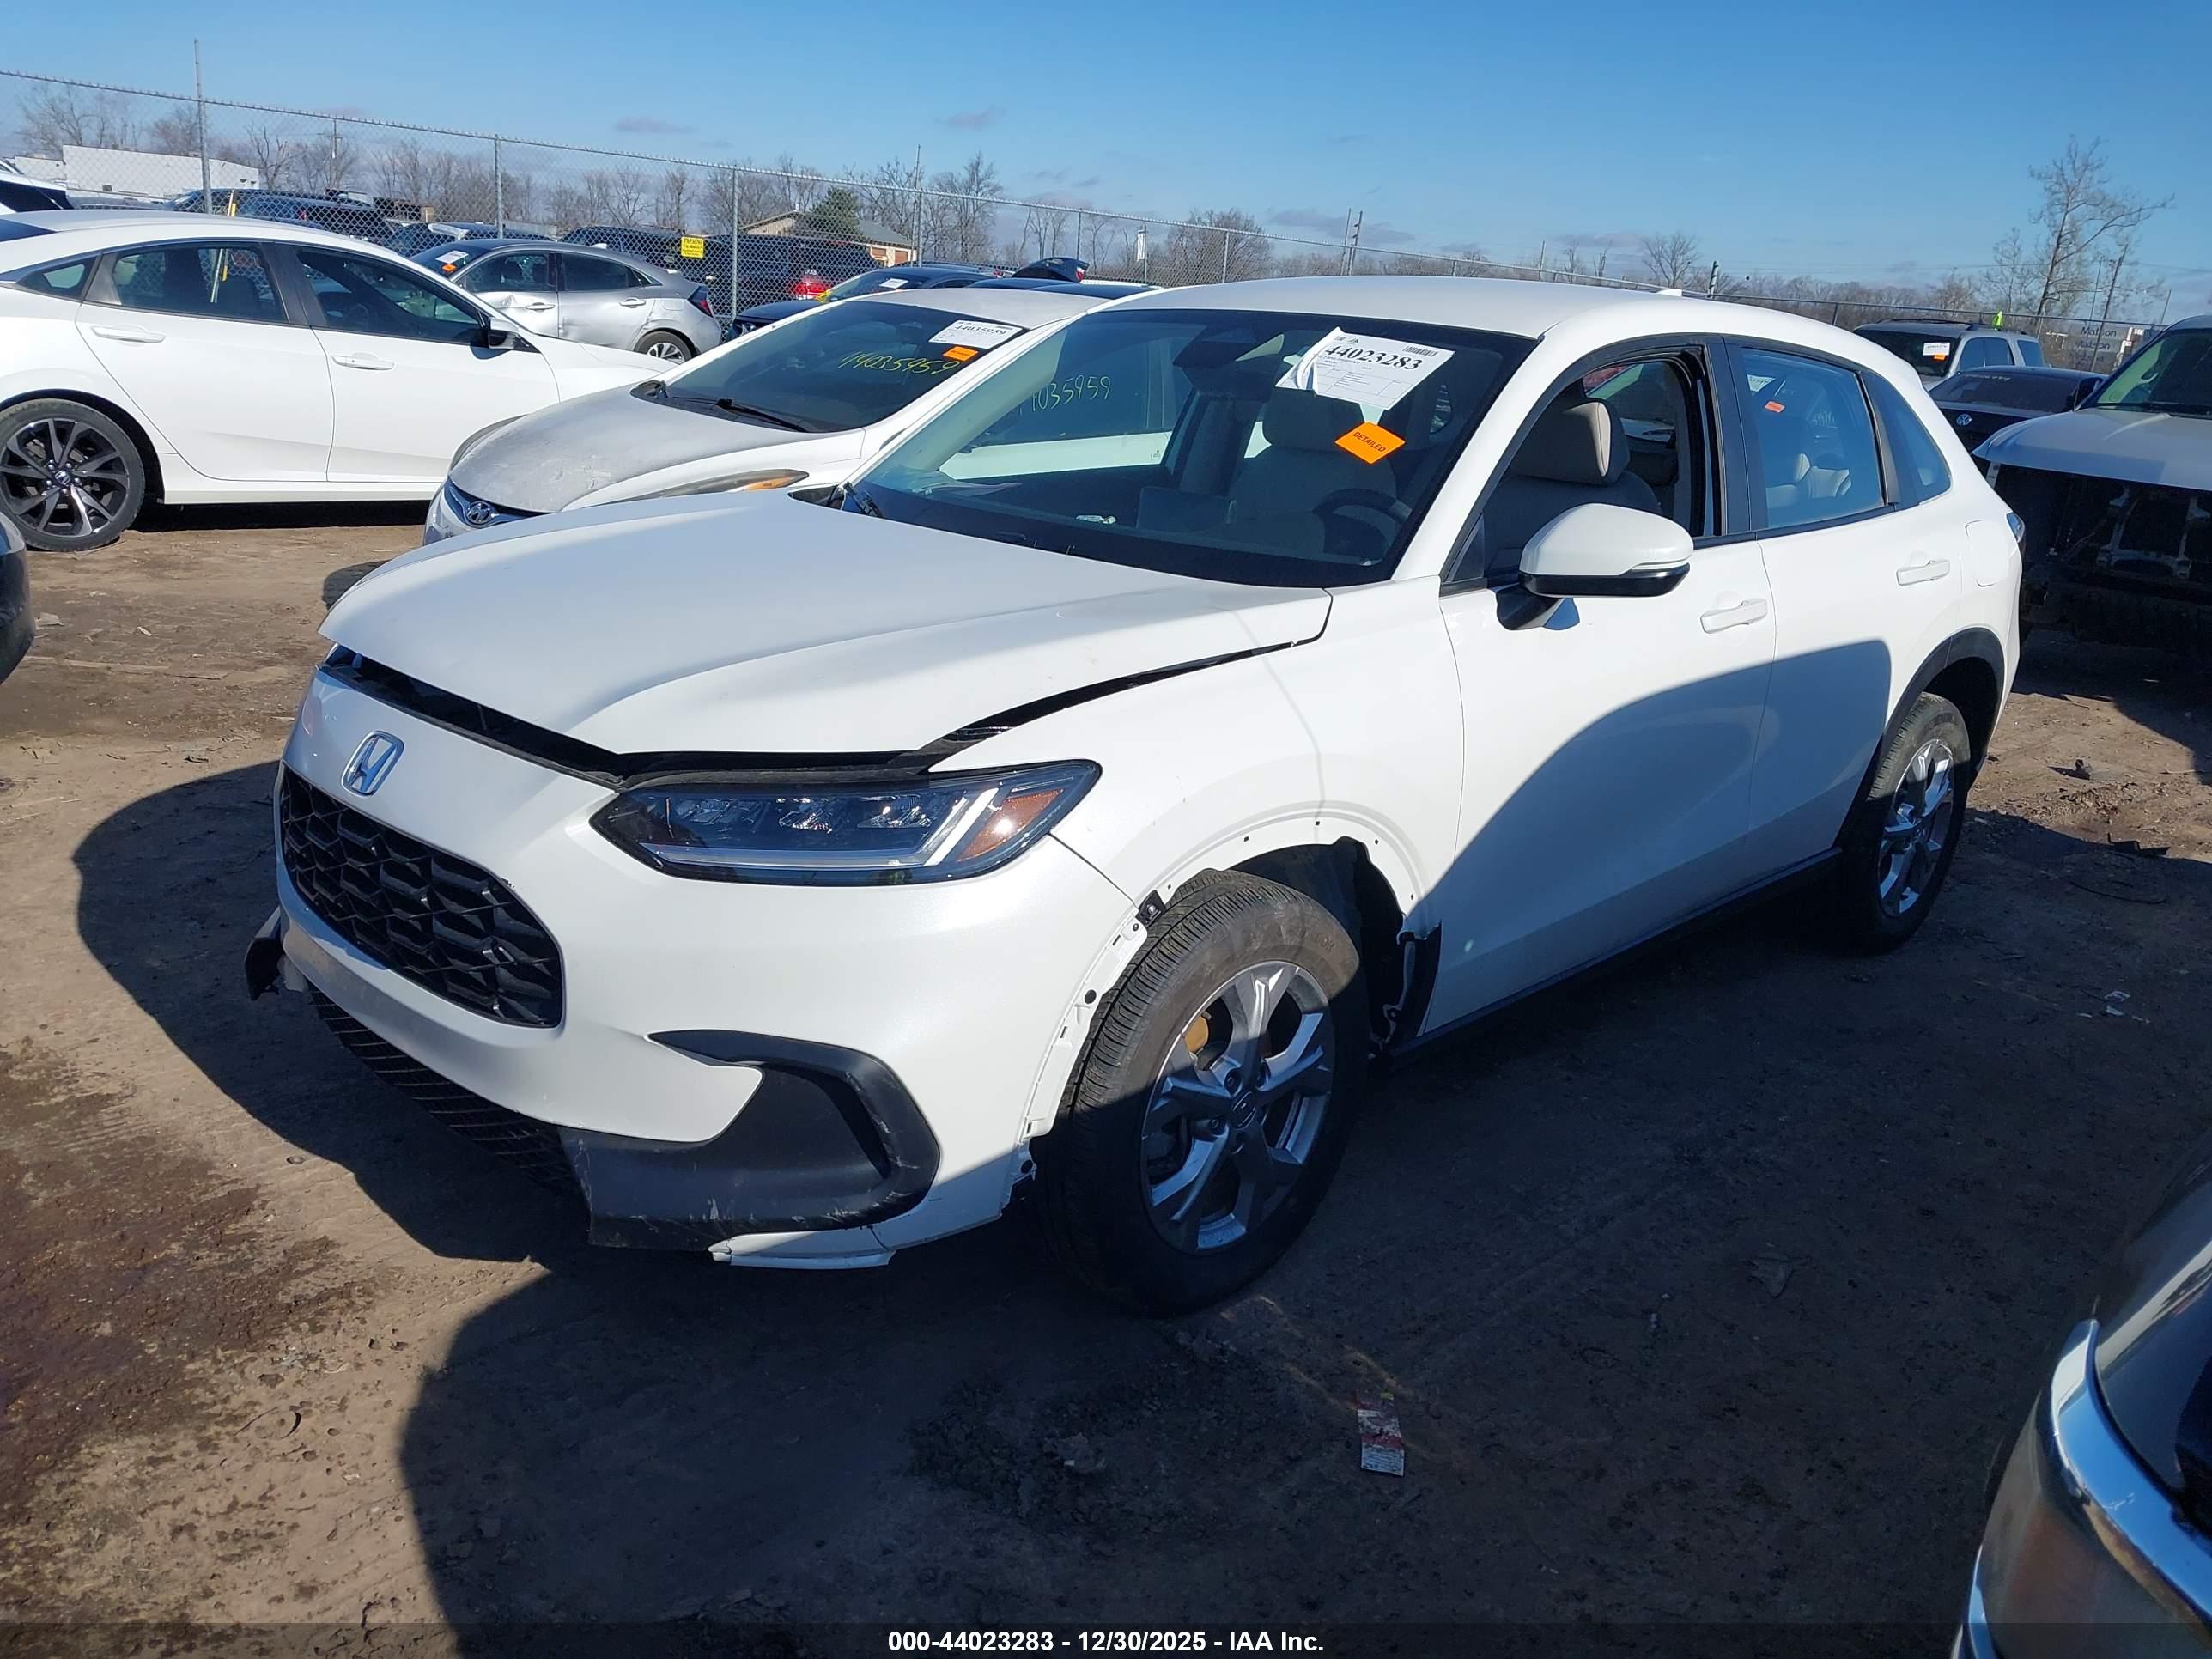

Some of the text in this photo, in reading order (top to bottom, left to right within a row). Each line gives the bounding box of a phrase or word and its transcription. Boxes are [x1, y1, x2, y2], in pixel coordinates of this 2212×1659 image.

[2081, 326, 2117, 337] Maton
[1325, 345, 1423, 370] 44023283
[1352, 431, 1387, 453] DETAILED
